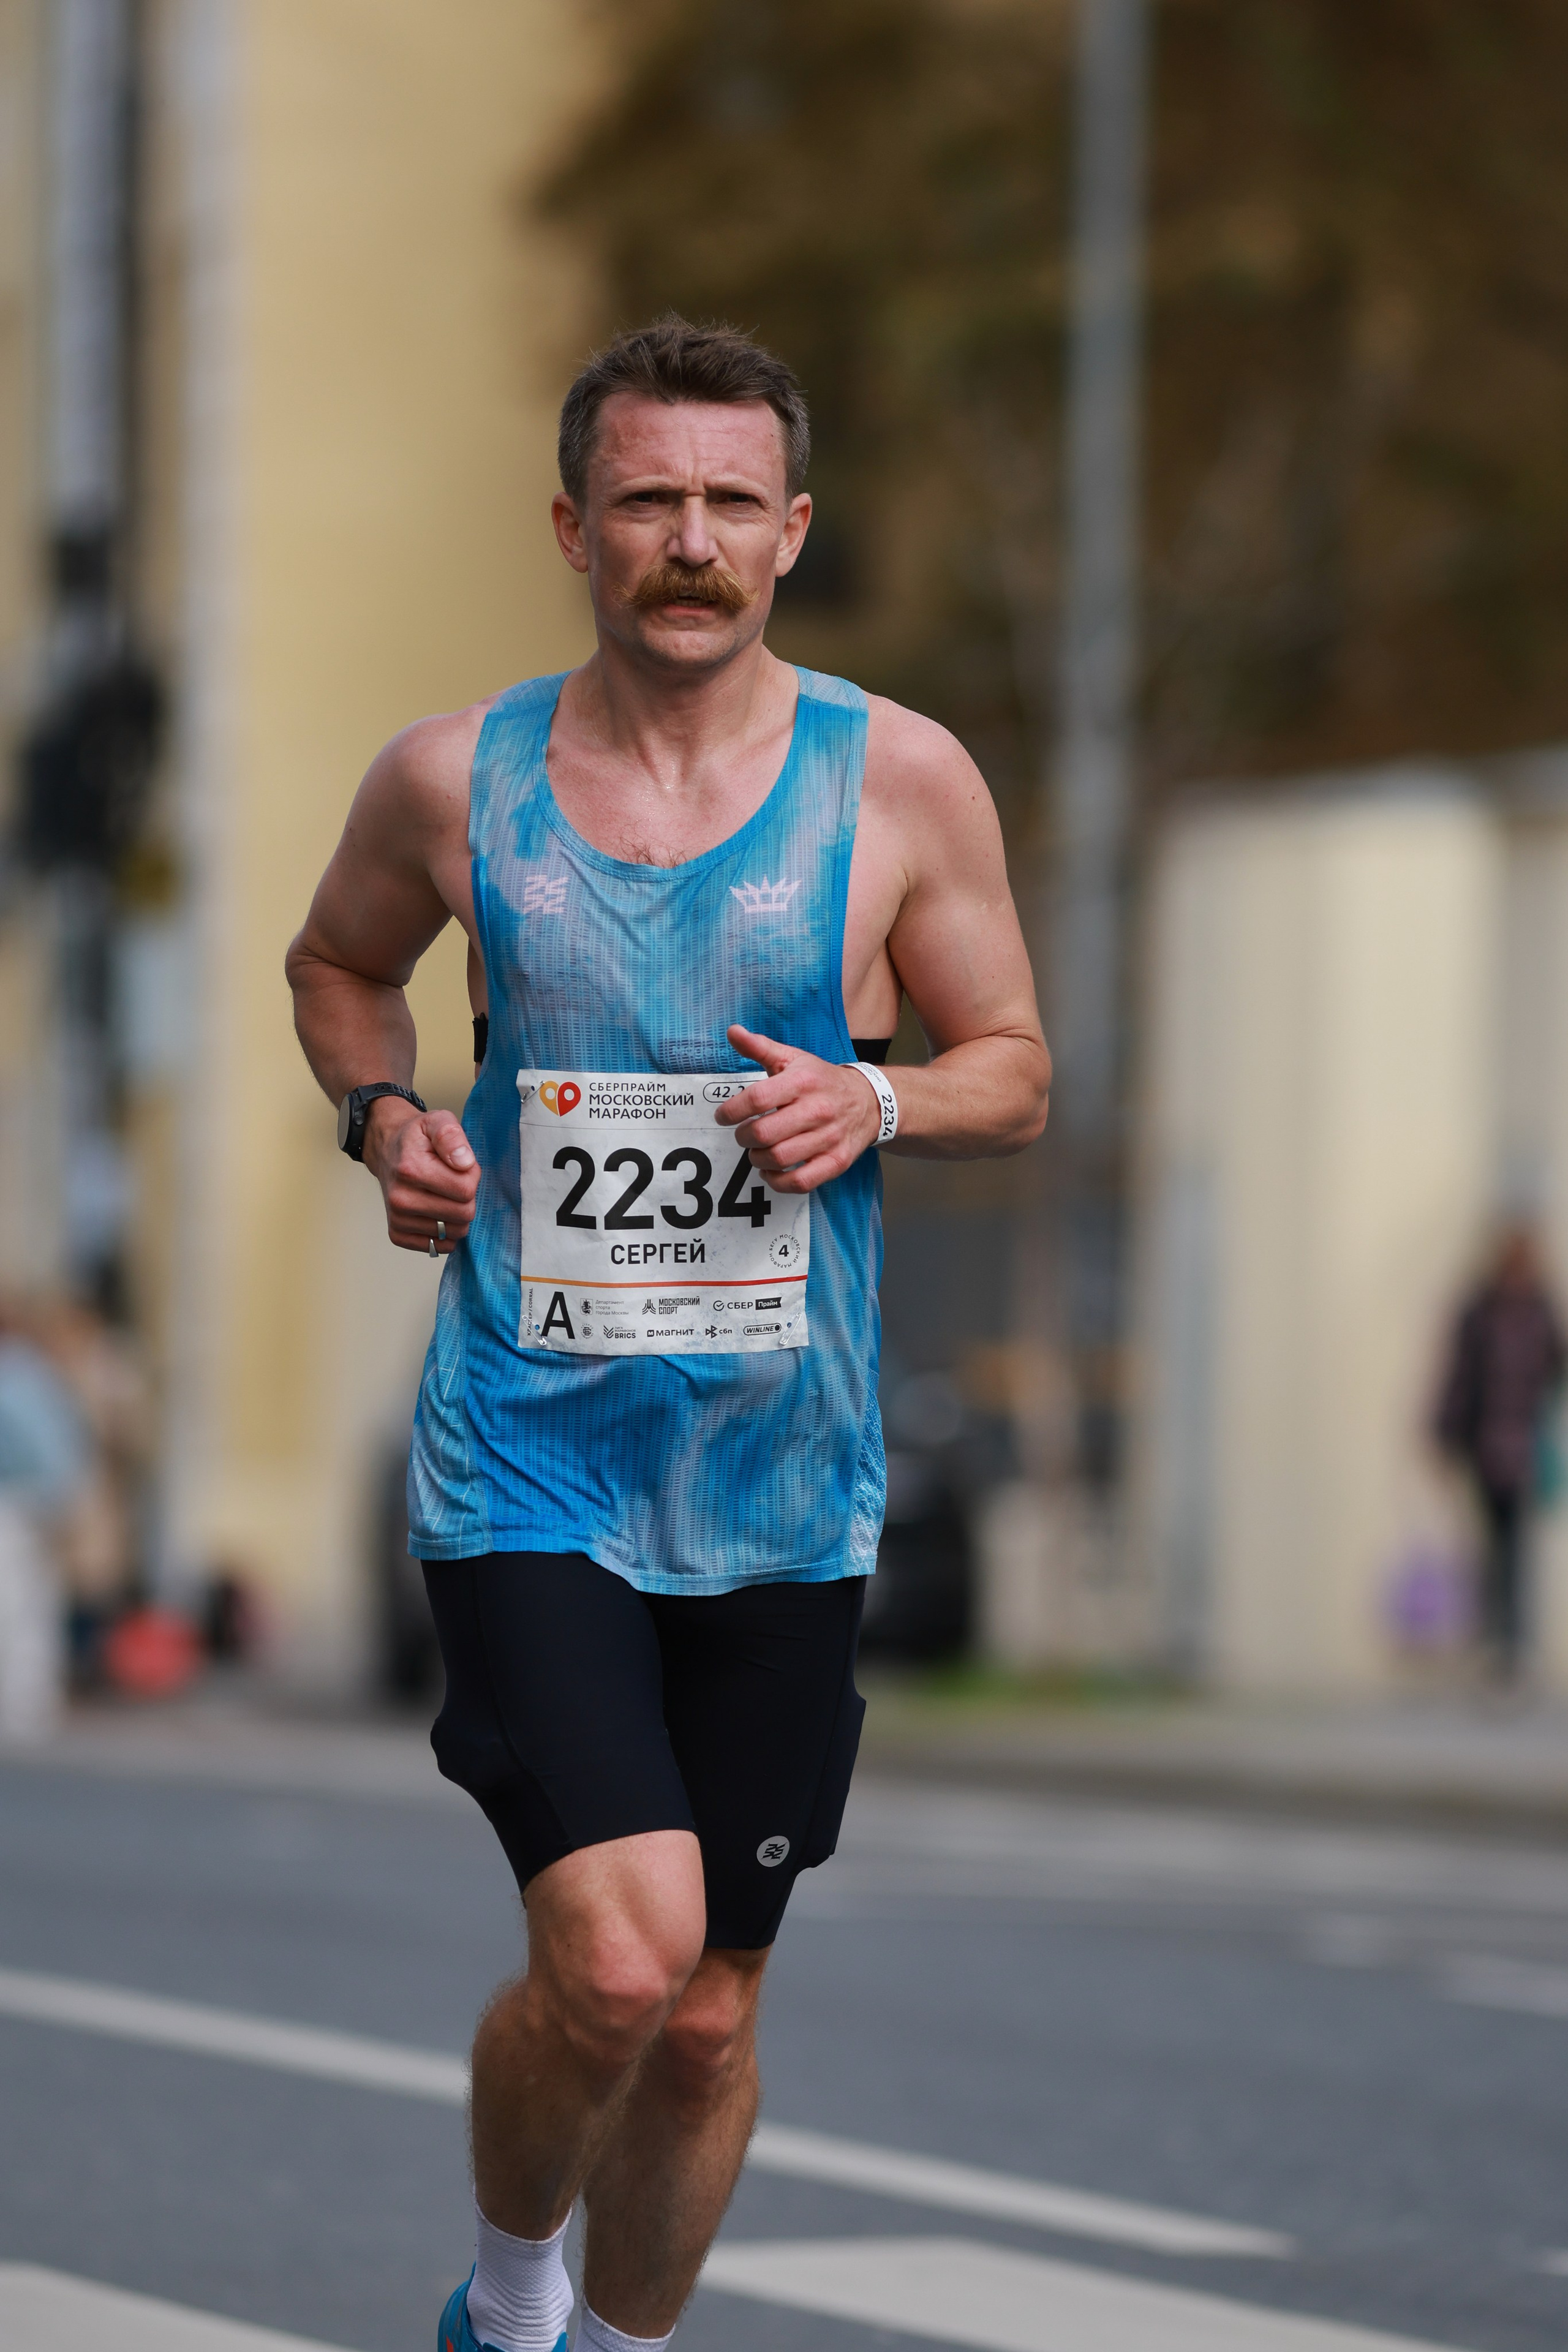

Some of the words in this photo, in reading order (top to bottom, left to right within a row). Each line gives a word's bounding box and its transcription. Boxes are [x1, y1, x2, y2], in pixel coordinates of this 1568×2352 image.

[589, 1082, 666, 1092] СБЕРПРАЙМ
[589, 1093, 693, 1106] МОСКОВСКИЙ
[589, 1108, 666, 1119] МАРАФОН
[881, 1094, 894, 1137] 2234
[552, 1146, 771, 1231] 2234
[611, 1238, 706, 1265] СЕРГЕЙ
[778, 1245, 790, 1257] 4
[779, 1234, 801, 1263] МОСКОВСКИЙ
[769, 1253, 792, 1268] МАРАФОН
[658, 1295, 700, 1306] МОСКОВСКИЙ
[727, 1301, 753, 1310] СБЕР
[758, 1300, 778, 1308] Прайм
[658, 1306, 678, 1314] СПОРТ
